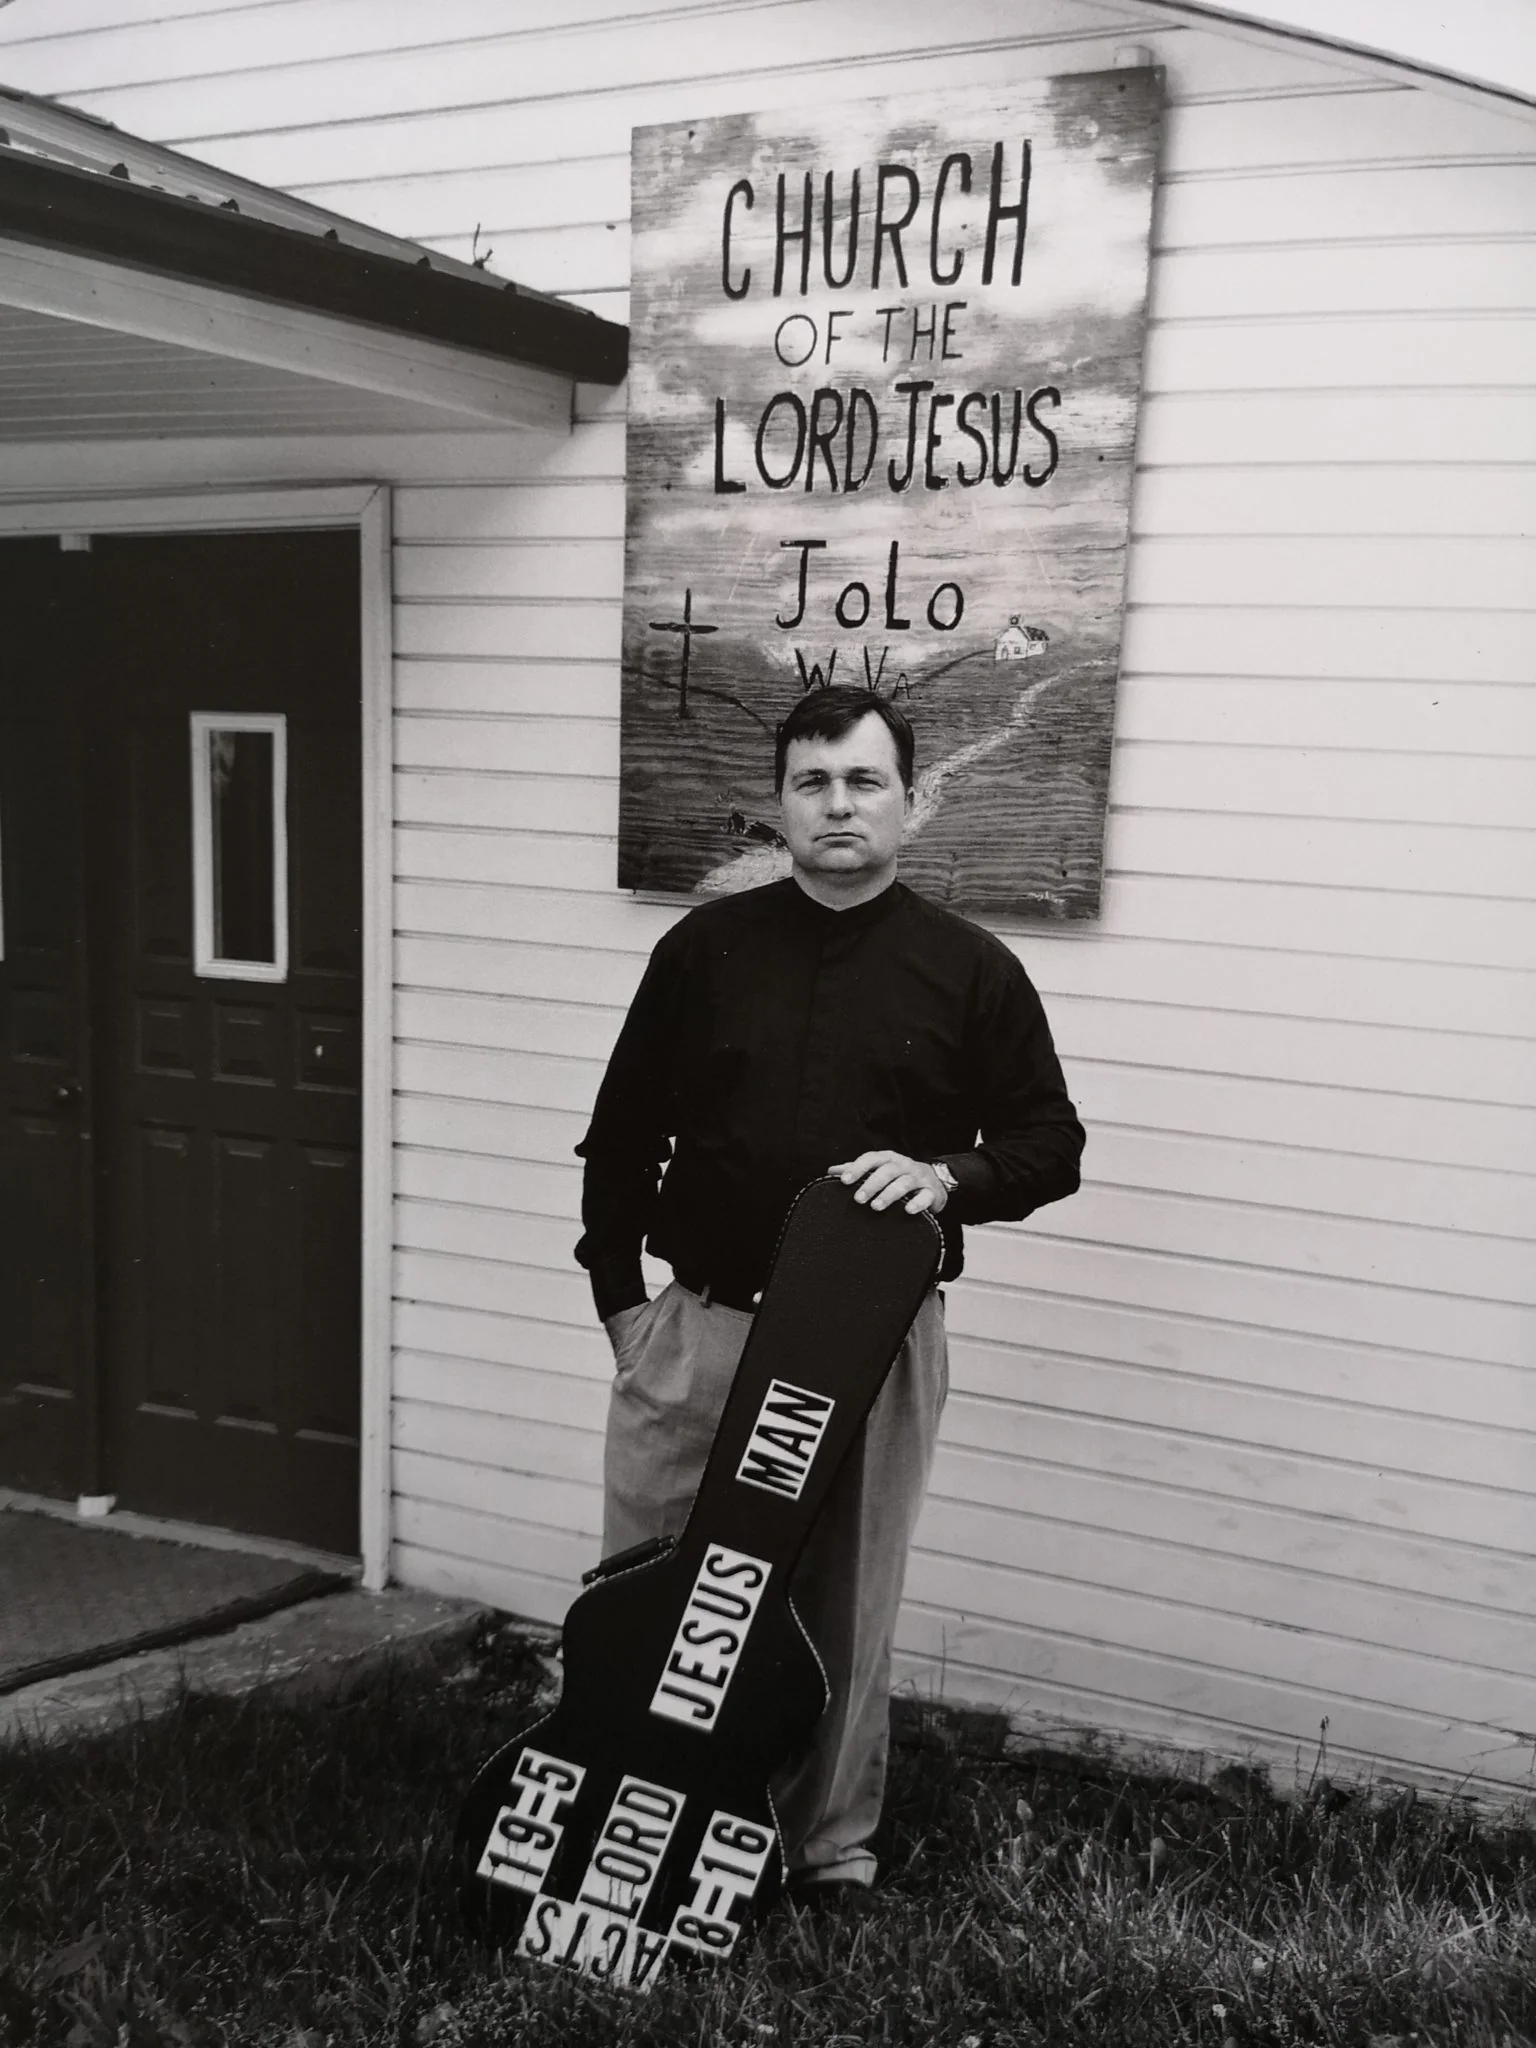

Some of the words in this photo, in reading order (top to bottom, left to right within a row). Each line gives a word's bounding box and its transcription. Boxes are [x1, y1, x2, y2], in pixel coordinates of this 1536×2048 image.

[722, 139, 1032, 299] CHURCH
[774, 310, 854, 367] OF
[876, 302, 967, 363] THE
[714, 387, 878, 494] LORD
[887, 381, 1062, 493] JESUS
[579, 1782, 678, 1920] LORD
[660, 1552, 764, 1721] JESUS
[740, 1382, 832, 1496] MAN
[525, 1900, 667, 1987] ACTS
[676, 1818, 769, 1948] 8-16
